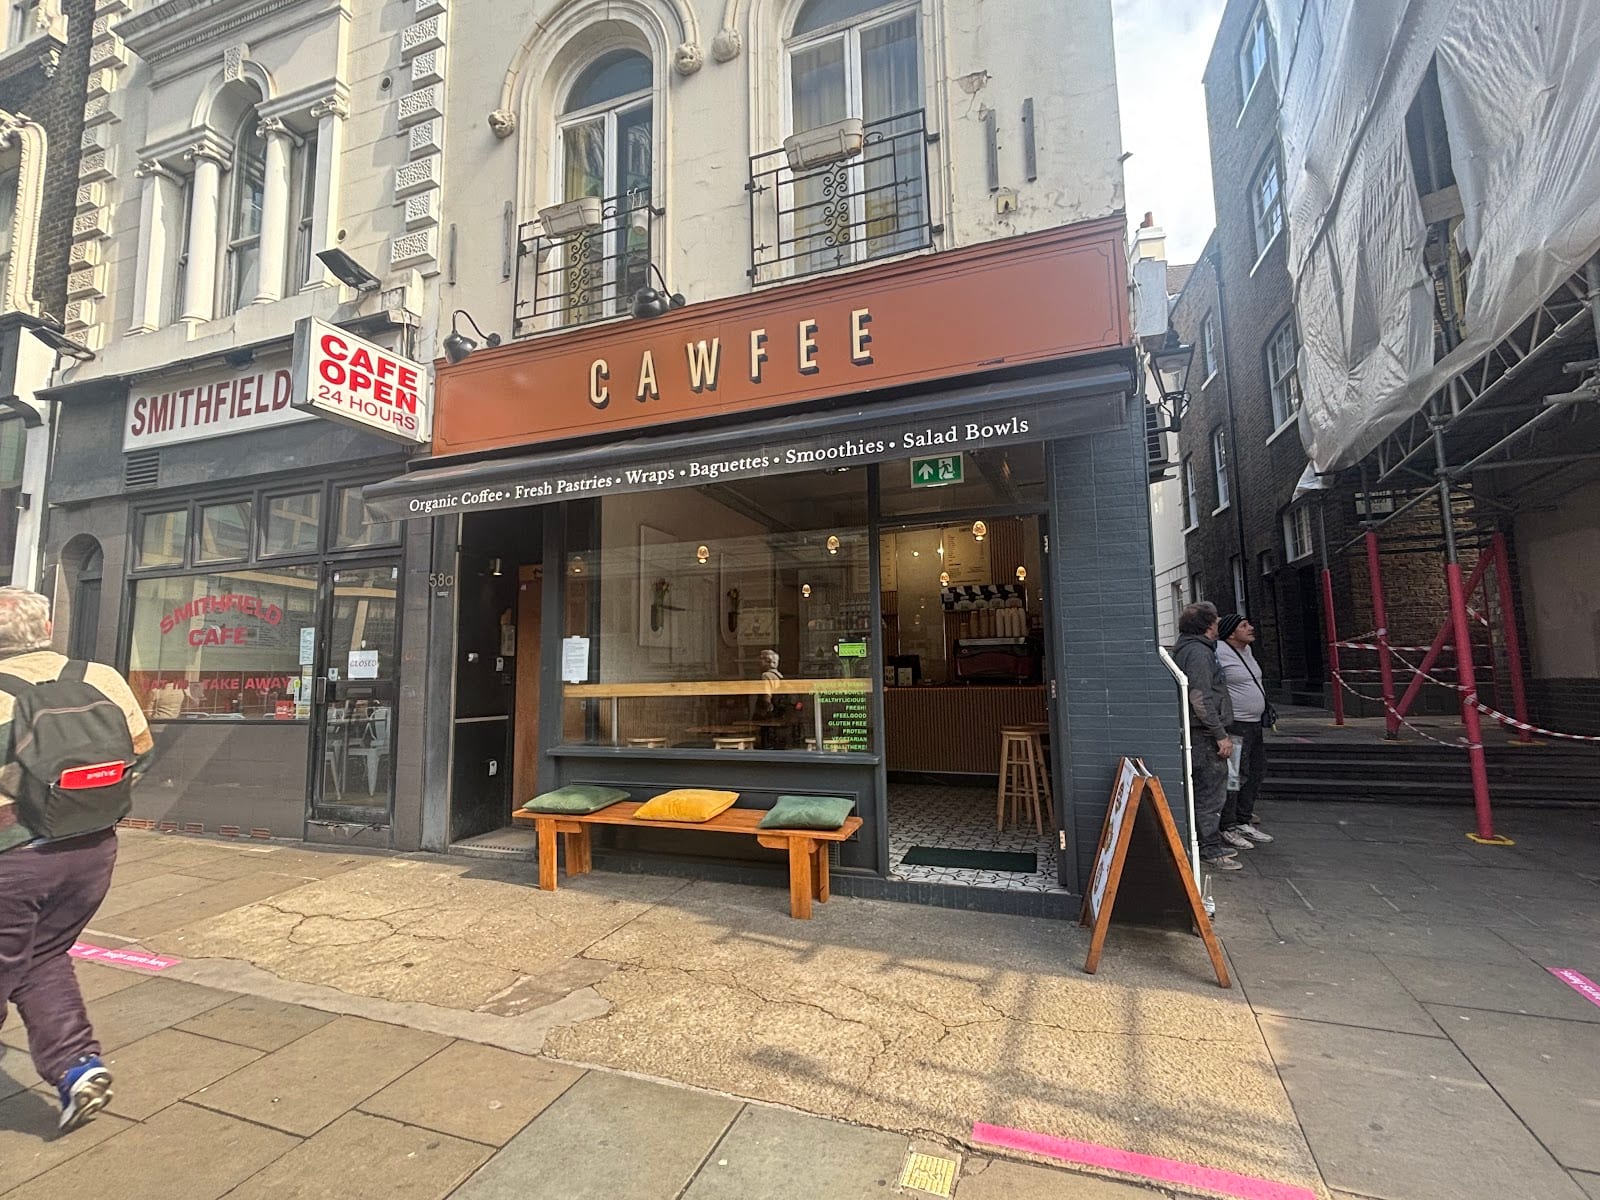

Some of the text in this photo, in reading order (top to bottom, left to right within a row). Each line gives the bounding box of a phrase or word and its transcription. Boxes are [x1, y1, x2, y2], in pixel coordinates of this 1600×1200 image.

[320, 334, 418, 393] CAFE
[589, 308, 873, 409] CAWFEE
[131, 368, 292, 436] SMITHFIELD
[318, 384, 417, 431] 24 HOURS
[319, 359, 418, 415] OPEN
[409, 416, 1030, 513] Organic Coffee Fresh Pastries Wraps Baguettes Smoothies Salad Bowls
[160, 593, 283, 635] SMITHFIELD
[188, 626, 248, 647] CAFE
[202, 678, 240, 690] TAKE
[245, 676, 290, 689] AWAY
[349, 658, 377, 668] CLOSED
